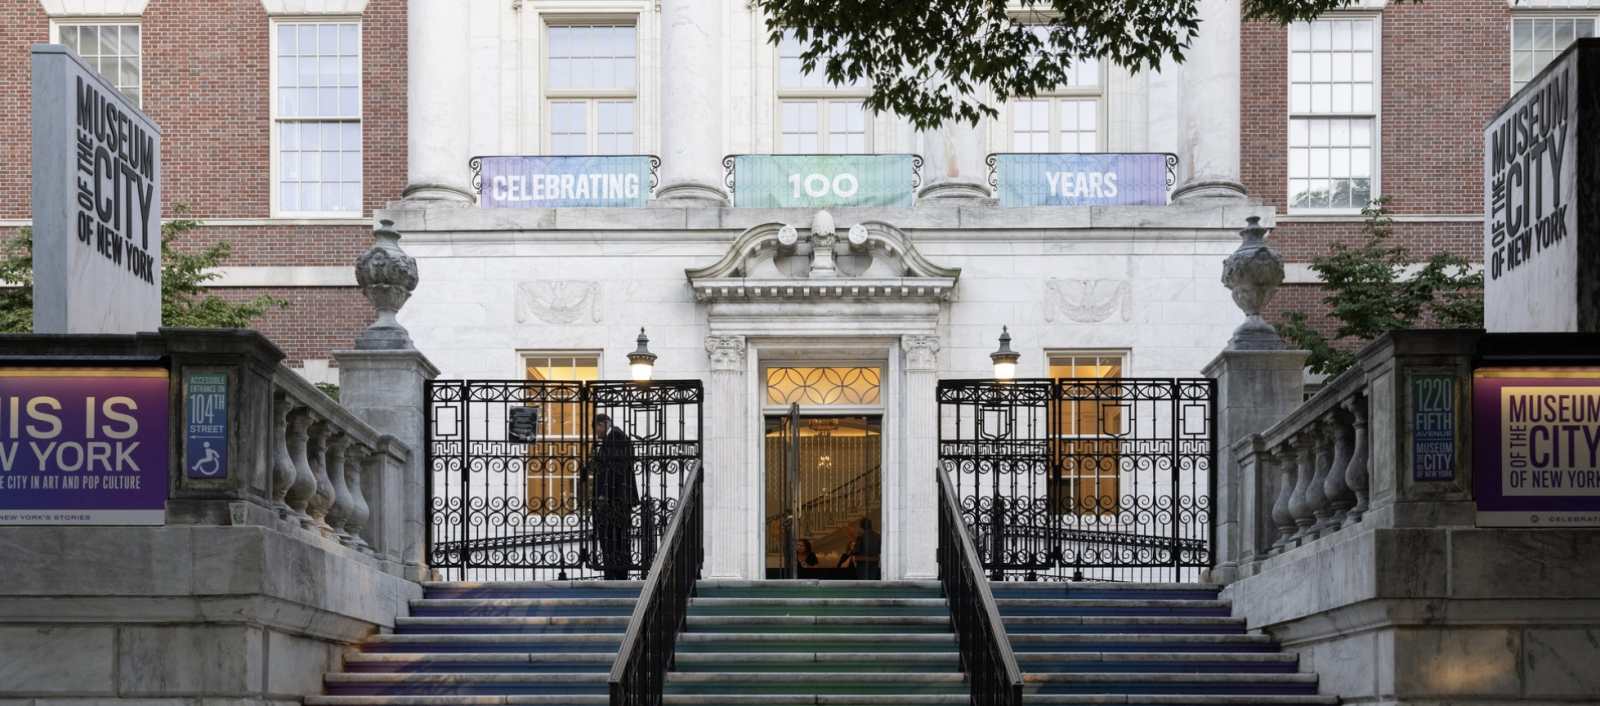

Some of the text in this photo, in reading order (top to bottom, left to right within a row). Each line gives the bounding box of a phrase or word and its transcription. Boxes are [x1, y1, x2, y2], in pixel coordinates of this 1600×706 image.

[77, 75, 154, 182] MUSEUM
[1492, 68, 1569, 177] MUSEUM
[77, 128, 94, 212] OF THE
[1045, 171, 1118, 199] YEARS
[1505, 123, 1568, 238] CITY
[94, 145, 154, 250] CITY
[492, 172, 639, 201] CELEBRATING
[787, 173, 859, 198] 100
[1491, 171, 1505, 249] OF THE
[77, 210, 154, 285] OF NEW YORK
[1491, 203, 1568, 281] OF NEW YORK
[190, 376, 225, 385] ACCESSIBLE
[190, 385, 225, 393] ENTRANCE ON
[1416, 378, 1452, 412] 1220
[0, 396, 139, 439] IS IS
[189, 394, 225, 424] 104TH
[1416, 412, 1452, 430] FIFTH
[1509, 394, 1600, 423] MUSEUM
[190, 425, 225, 433] STREET
[29, 441, 141, 472] YORK
[1416, 442, 1453, 453] MUSEUM
[1509, 425, 1527, 468] OF THE
[1529, 425, 1600, 468] CITY
[1416, 470, 1453, 478] OF NEW YORK
[1424, 453, 1452, 471] CITY
[7, 475, 28, 489] CITY
[30, 475, 40, 489] IN
[42, 475, 59, 489] ART
[62, 475, 80, 489] AND
[82, 475, 100, 489] POP
[103, 475, 141, 489] CULTURE
[1510, 470, 1527, 488] OF
[1532, 470, 1563, 488] NEW
